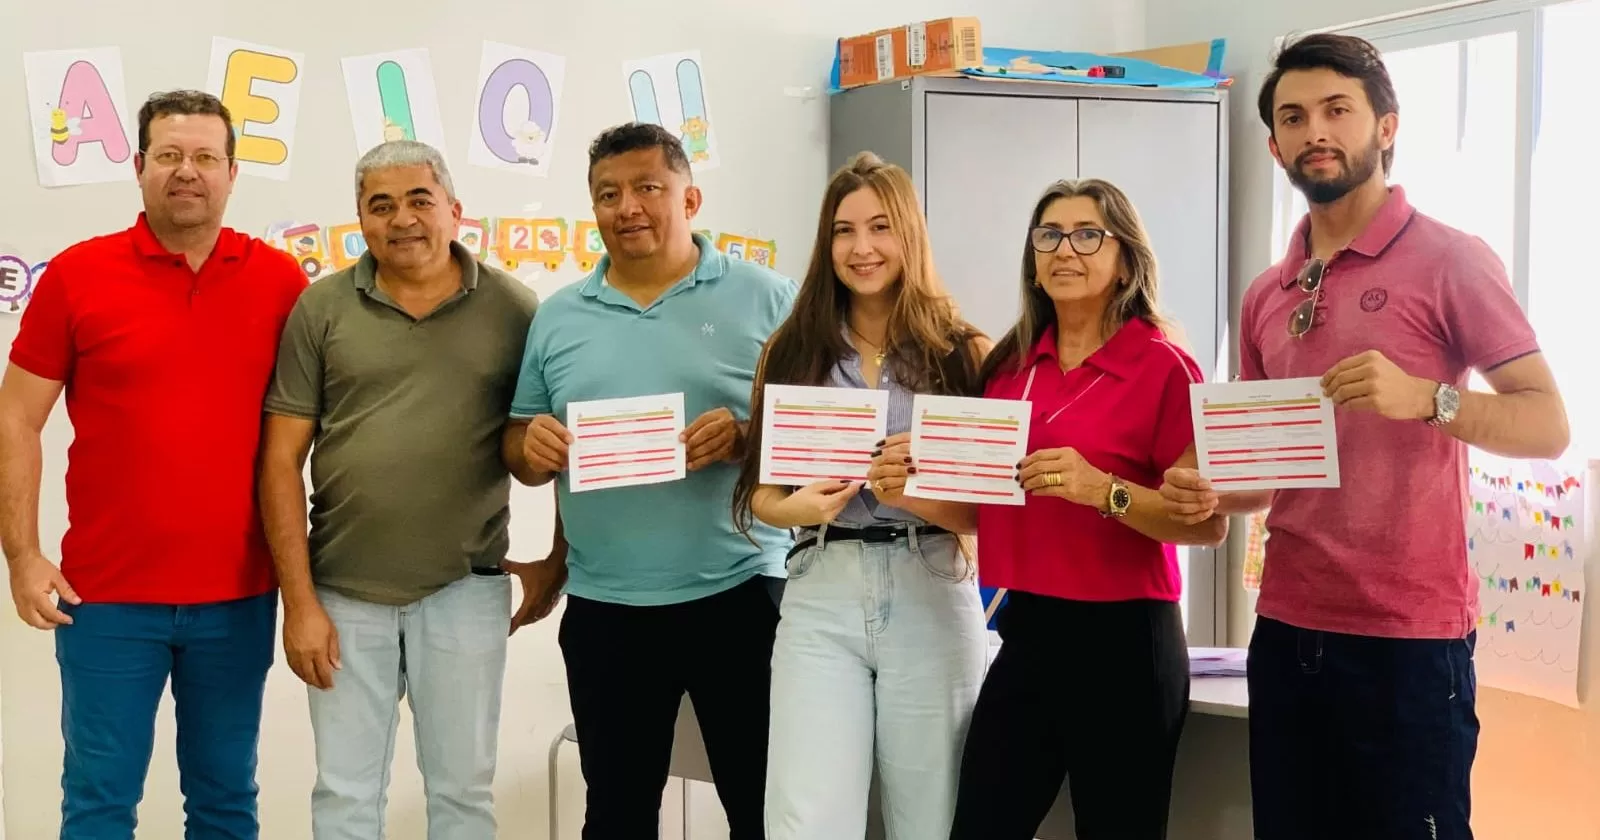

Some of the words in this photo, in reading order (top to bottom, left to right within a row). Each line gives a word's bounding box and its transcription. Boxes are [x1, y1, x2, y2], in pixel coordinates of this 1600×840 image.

[51, 60, 131, 166] A
[221, 48, 298, 165] E
[478, 58, 554, 163] O
[513, 226, 529, 250] 2
[588, 228, 603, 252] 3
[729, 242, 743, 260] 5
[0, 267, 18, 291] E
